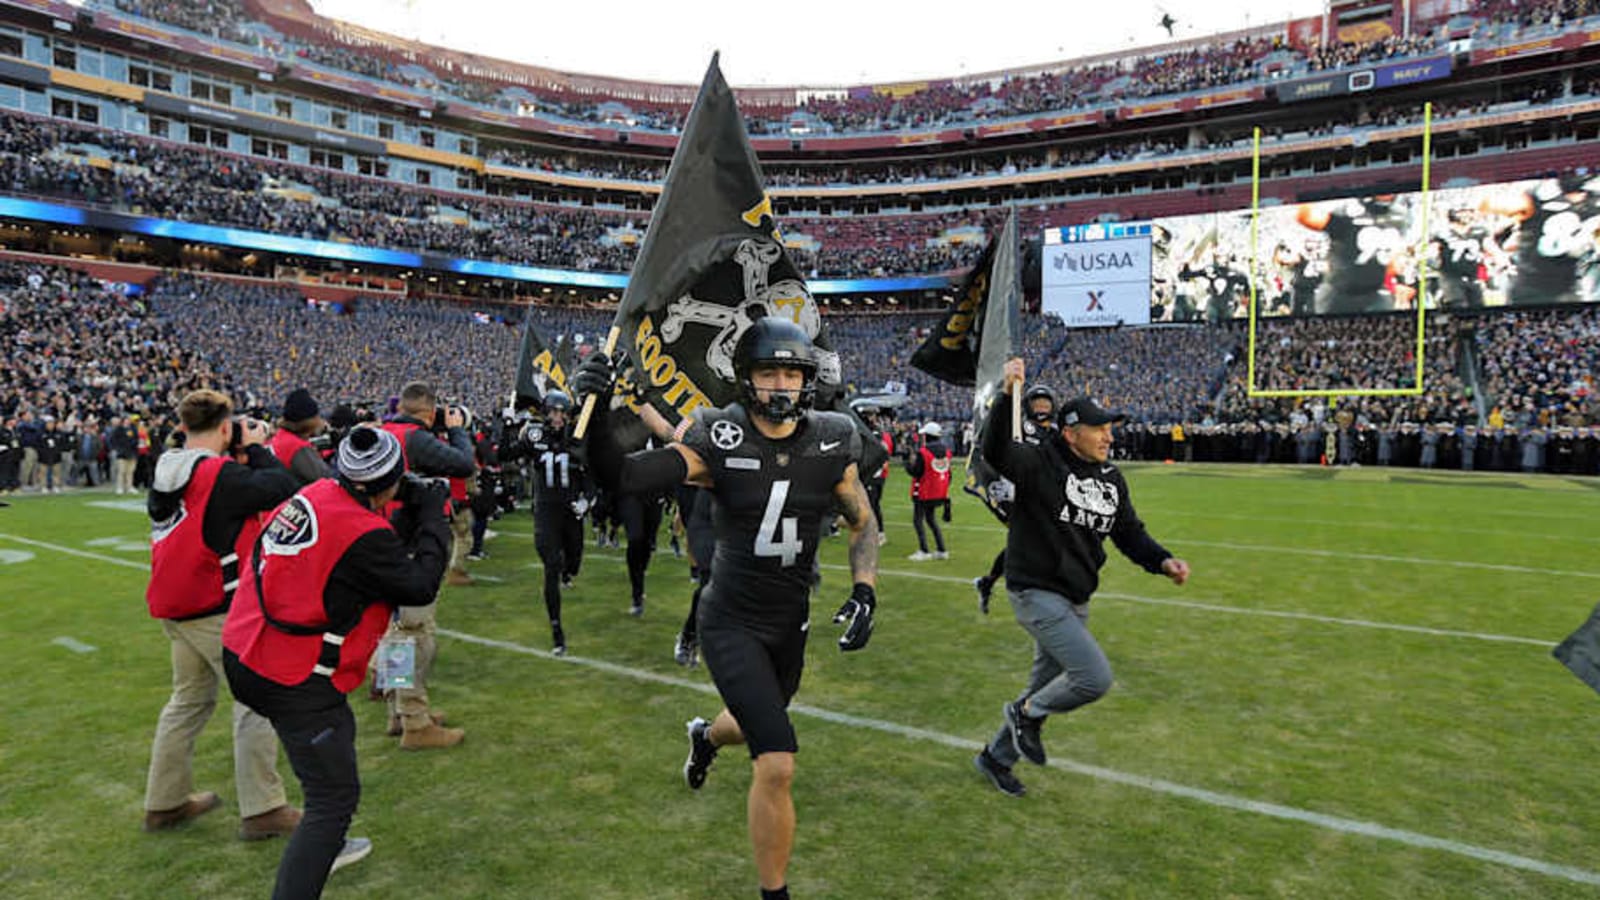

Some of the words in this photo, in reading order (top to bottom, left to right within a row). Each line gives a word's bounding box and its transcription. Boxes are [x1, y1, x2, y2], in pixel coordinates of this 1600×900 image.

[1080, 252, 1133, 271] USAA
[539, 451, 569, 488] 11
[754, 480, 803, 567] 4
